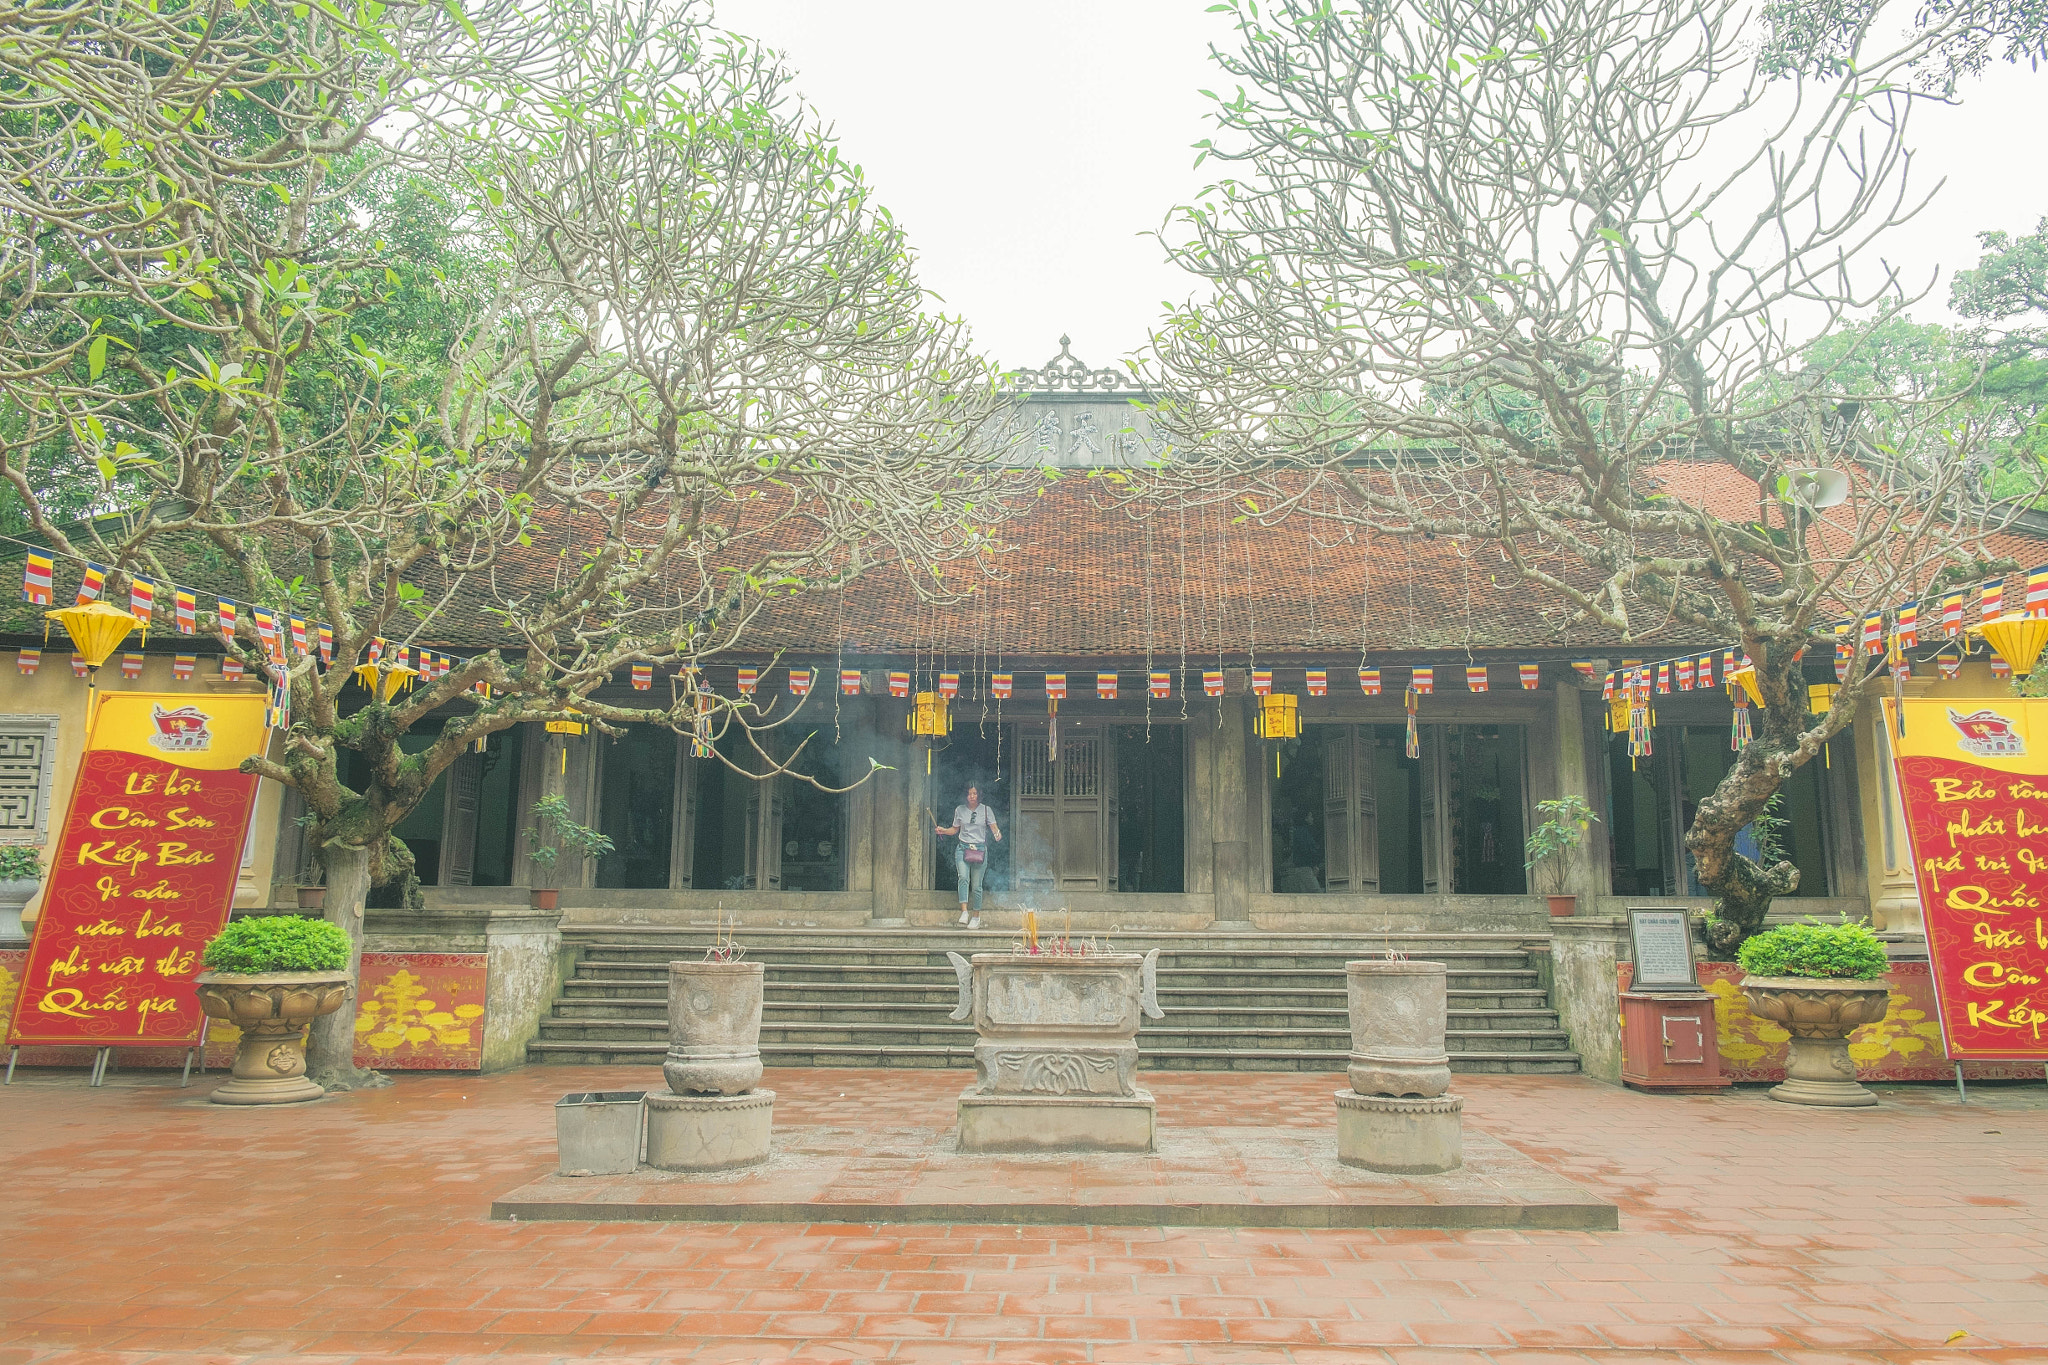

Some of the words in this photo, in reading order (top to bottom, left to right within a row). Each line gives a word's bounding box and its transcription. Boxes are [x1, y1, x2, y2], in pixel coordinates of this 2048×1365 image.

[125, 772, 156, 795] Lễ
[164, 768, 203, 796] hội
[1929, 777, 1997, 803] Bảo
[90, 806, 159, 830] Côn
[165, 806, 216, 831] Sơn
[1946, 808, 2007, 848] phát
[2016, 808, 2048, 838] hu
[77, 840, 151, 877] Kiếp
[156, 841, 216, 867] Bạc
[1924, 851, 1966, 893] giá
[1974, 855, 2011, 875] trị
[96, 876, 121, 902] di
[127, 879, 182, 900] sản
[1946, 883, 2041, 915] Quốc
[74, 918, 127, 937] văn
[135, 908, 183, 939] hóa
[1973, 922, 2026, 949] đặc
[47, 945, 90, 987] phi
[98, 955, 145, 977] vật
[155, 946, 196, 977] thể
[1963, 962, 2041, 988] Côn
[38, 986, 129, 1018] Quốc
[137, 996, 177, 1035] gia
[1967, 998, 2048, 1040] Kiếp
